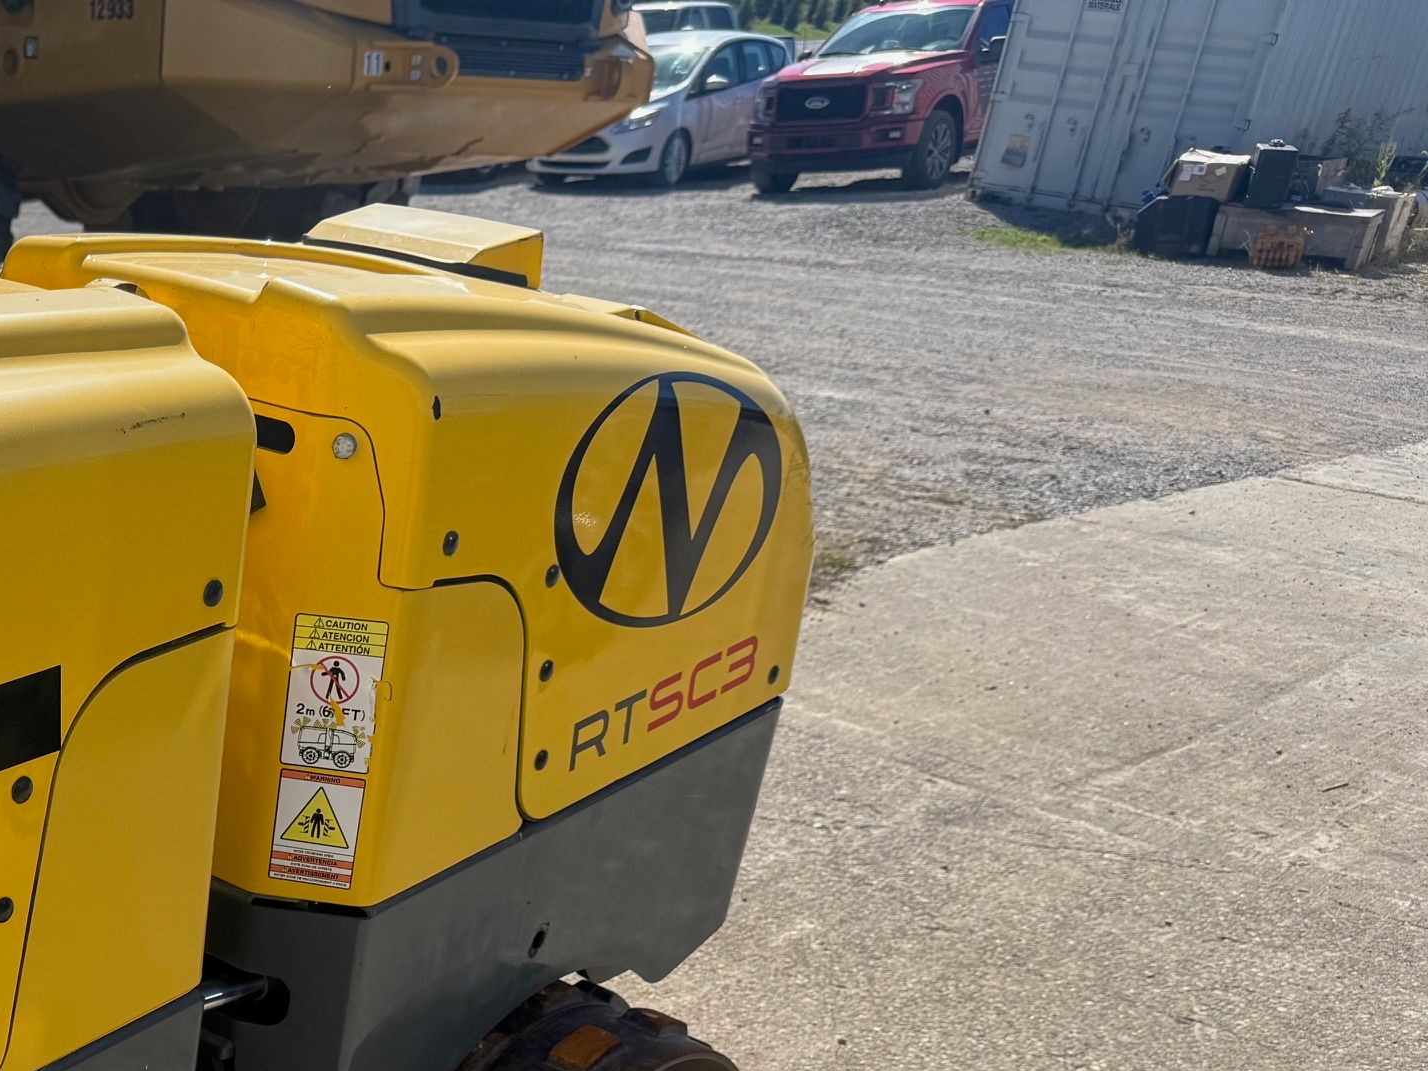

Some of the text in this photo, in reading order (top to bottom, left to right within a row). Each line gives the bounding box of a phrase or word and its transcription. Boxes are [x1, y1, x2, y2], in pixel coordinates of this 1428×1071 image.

[325, 619, 369, 632] CAUTION
[321, 631, 370, 644] ATENCION
[317, 642, 371, 655] ATTENTIÓN
[569, 635, 759, 773] RTSC3
[310, 774, 341, 784] WARNING
[293, 855, 338, 867] ADVERTENCIA
[288, 867, 339, 880] AVERTISSEMENT
